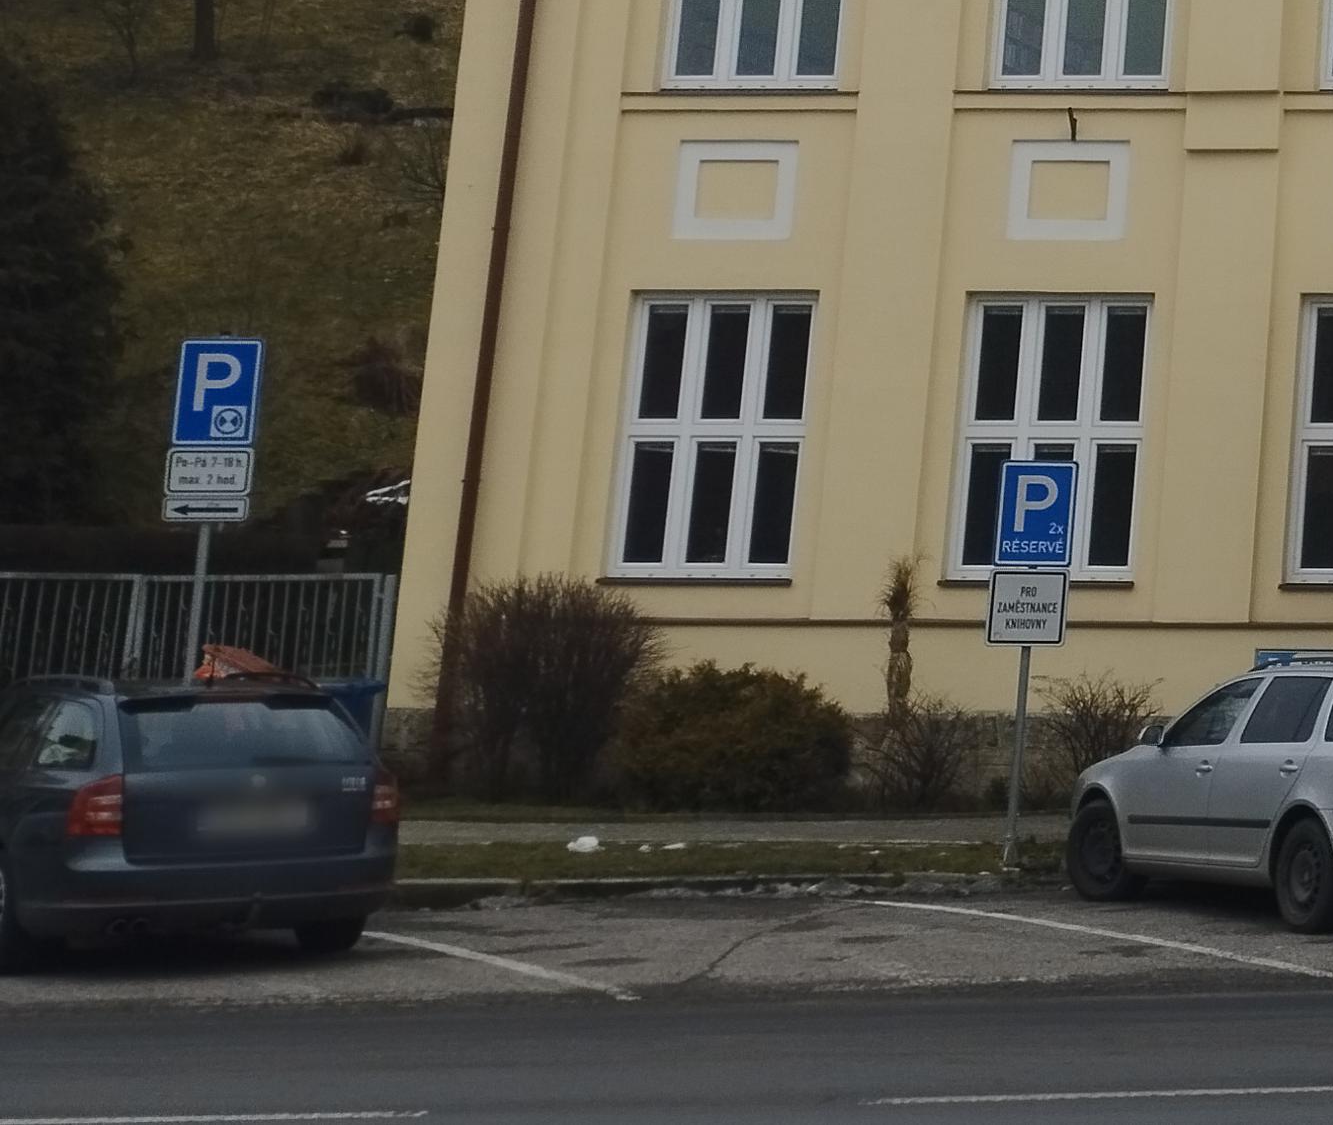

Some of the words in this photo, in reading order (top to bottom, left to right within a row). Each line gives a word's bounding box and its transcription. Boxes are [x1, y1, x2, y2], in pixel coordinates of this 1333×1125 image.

[193, 353, 242, 412] P
[1013, 475, 1059, 532] P
[1048, 522, 1064, 535] 2x
[1020, 586, 1038, 597] PRO
[997, 600, 1058, 613] ZAMĚSTNANCE
[1005, 618, 1048, 630] KNIHOVNY
